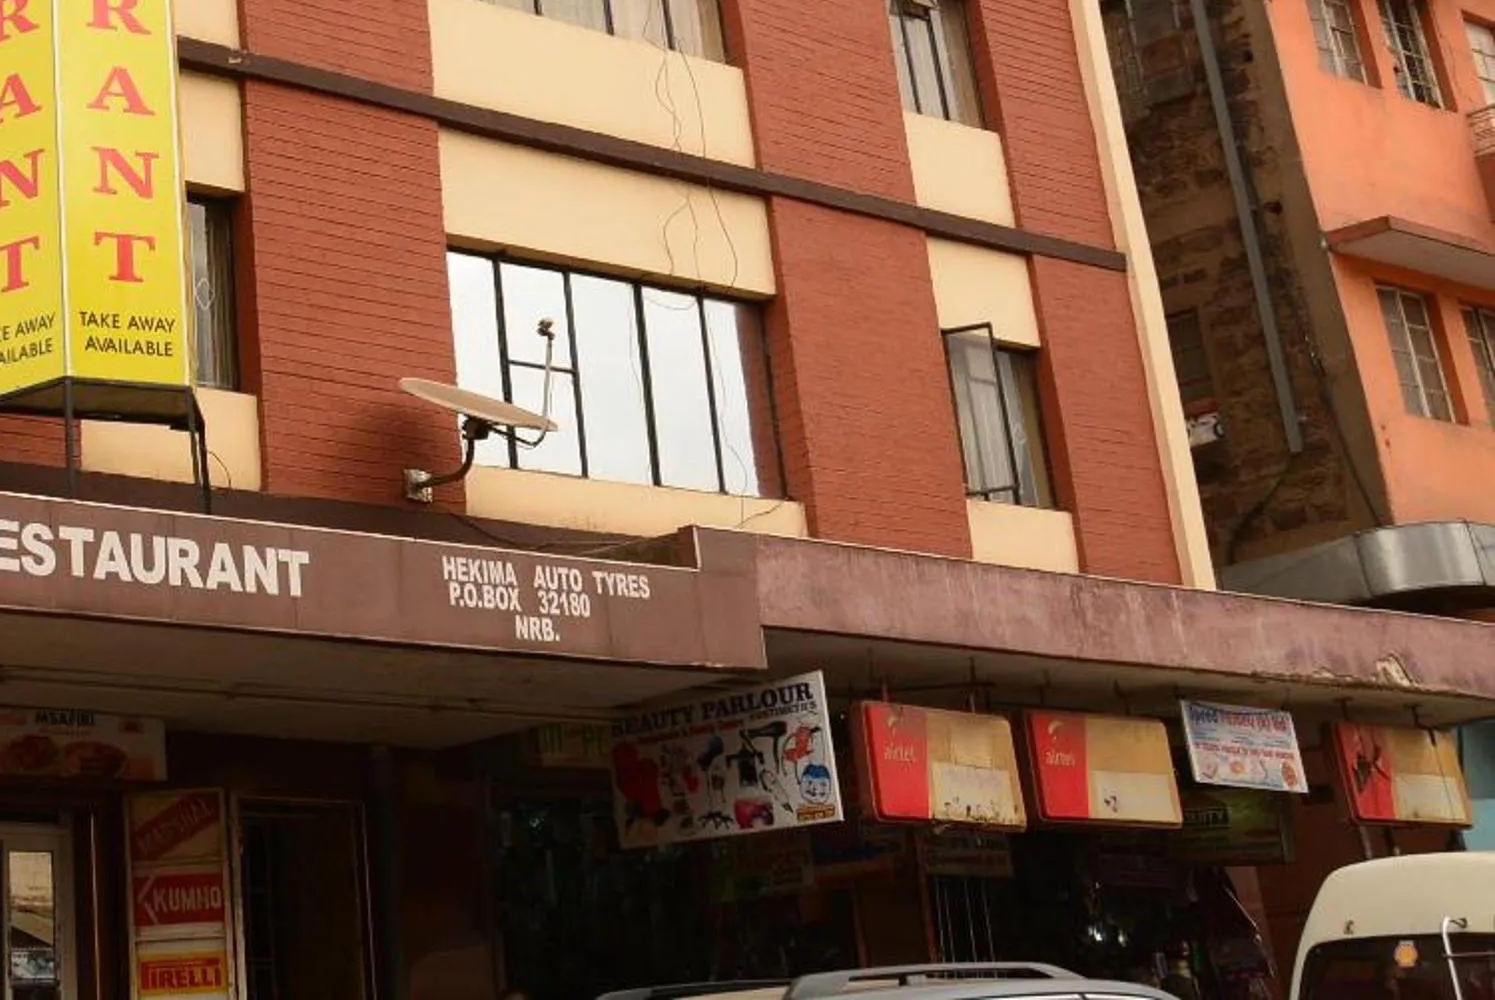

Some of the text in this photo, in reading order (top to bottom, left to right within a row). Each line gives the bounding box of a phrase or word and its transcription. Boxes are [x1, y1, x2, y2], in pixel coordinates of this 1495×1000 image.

[15, 312, 56, 338] AWAY
[79, 311, 176, 333] TAKE AWAY
[84, 336, 173, 357] AVAILABLE
[442, 556, 652, 600] HEKIMA AUTO TYRES
[537, 590, 591, 618] 32180
[612, 703, 696, 738] BEAUTY
[701, 682, 814, 720] PARLOUR
